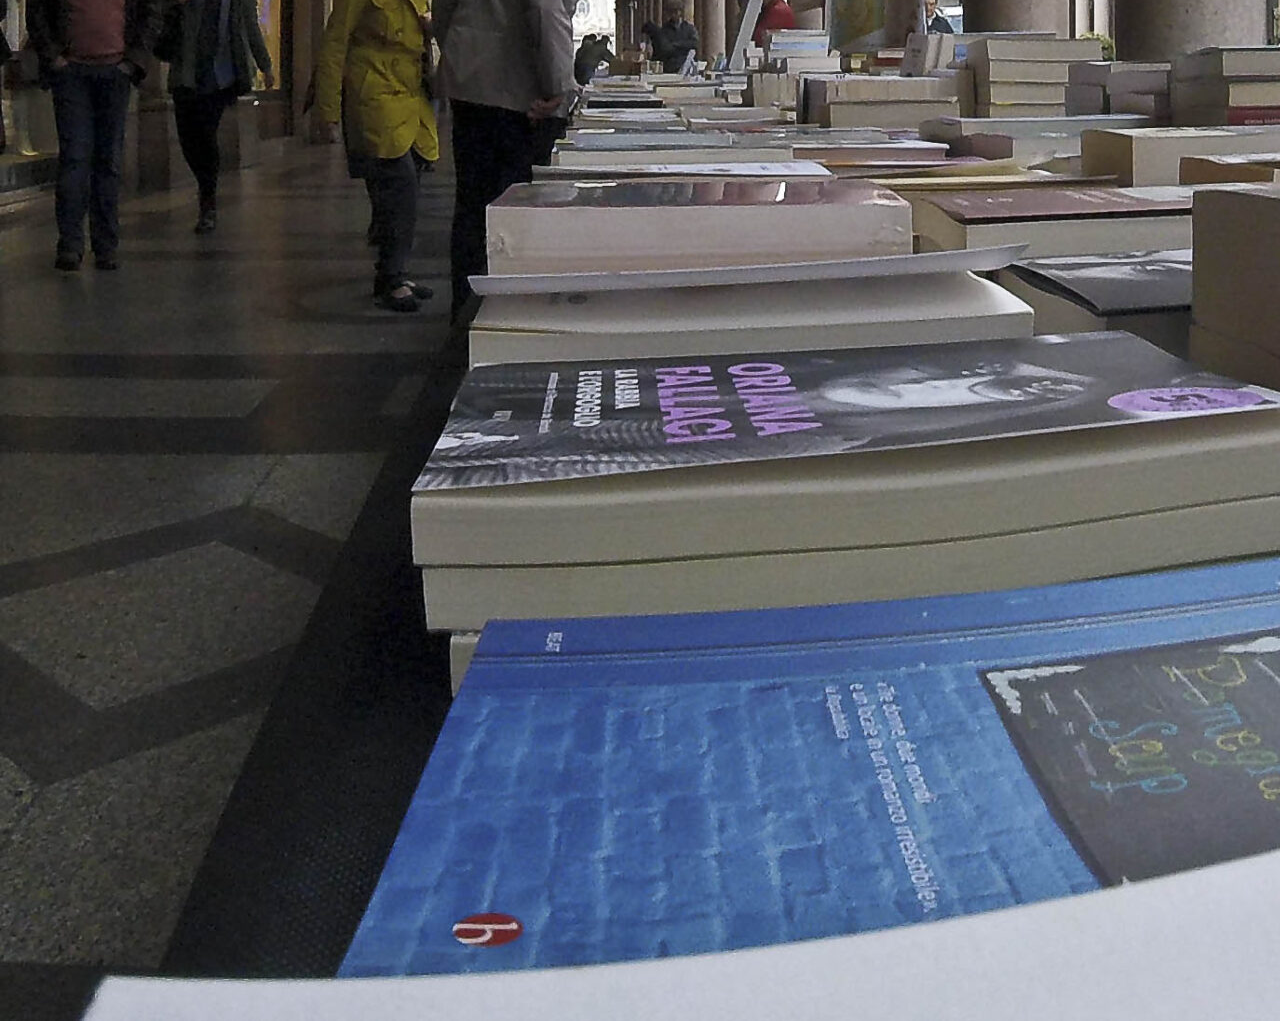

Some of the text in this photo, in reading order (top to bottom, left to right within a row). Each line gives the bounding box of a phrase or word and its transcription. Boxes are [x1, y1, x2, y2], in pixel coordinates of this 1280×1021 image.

[615, 369, 640, 410] LA RABBIA
[655, 365, 737, 444] FALLACI
[727, 363, 824, 436] ORIANA
[876, 768, 908, 824] romanzo
